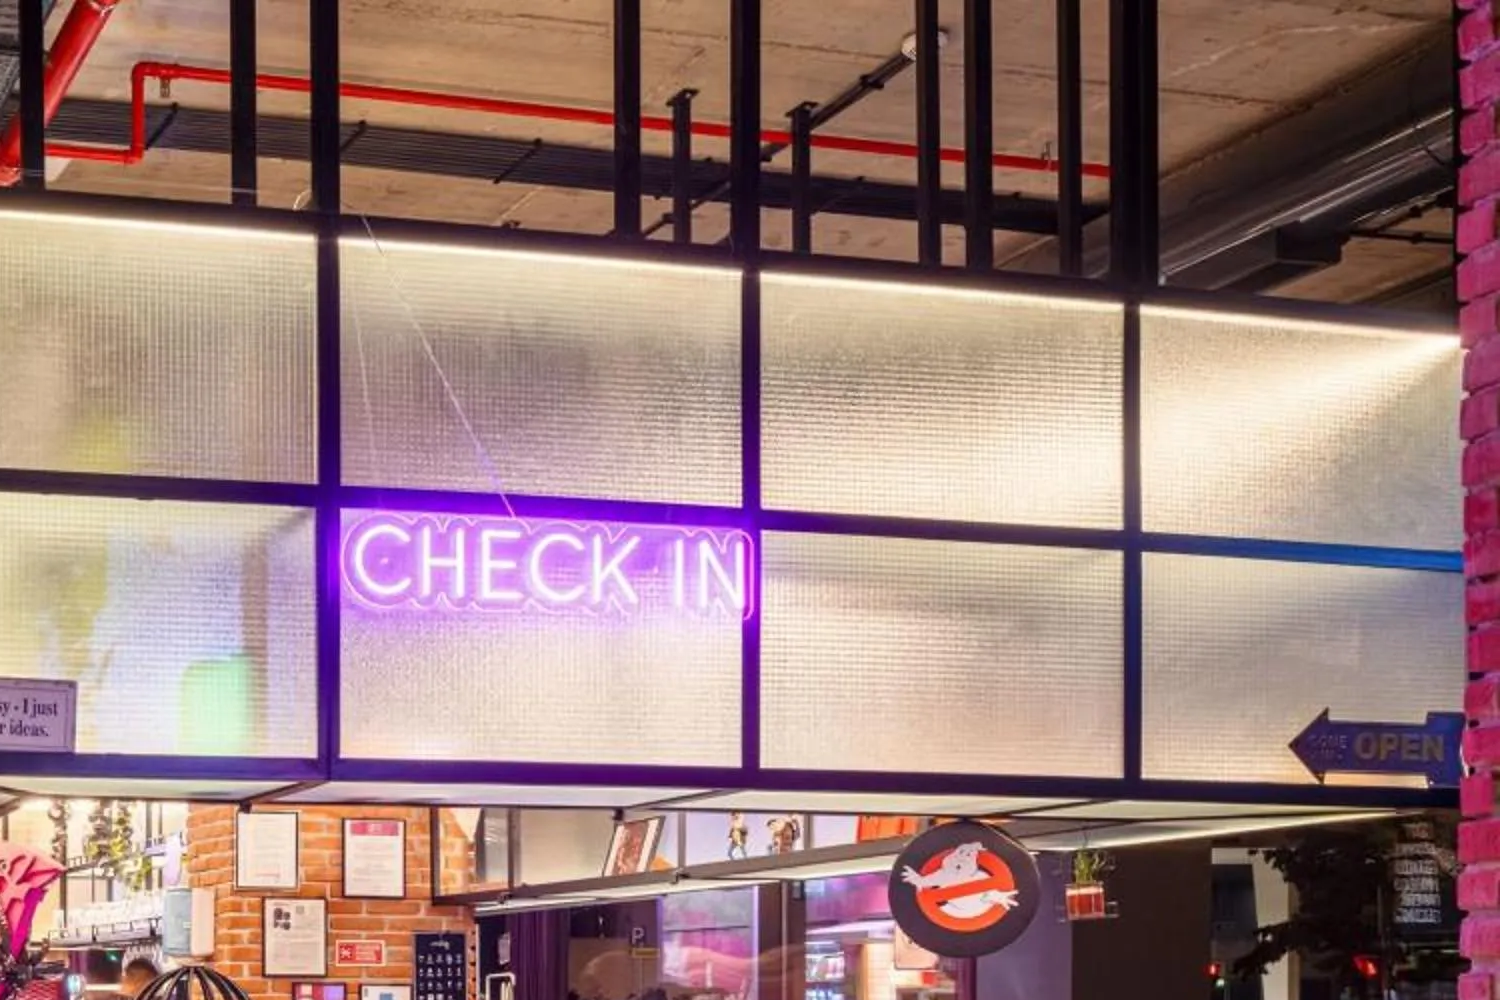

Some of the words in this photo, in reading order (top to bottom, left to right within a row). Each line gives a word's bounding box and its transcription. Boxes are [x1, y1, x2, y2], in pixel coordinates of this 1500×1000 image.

[354, 520, 640, 604] CHECK
[672, 538, 744, 609] IN
[23, 698, 28, 714] I
[30, 699, 58, 717] just
[9, 720, 49, 737] ideas.
[1355, 732, 1445, 761] OPEN
